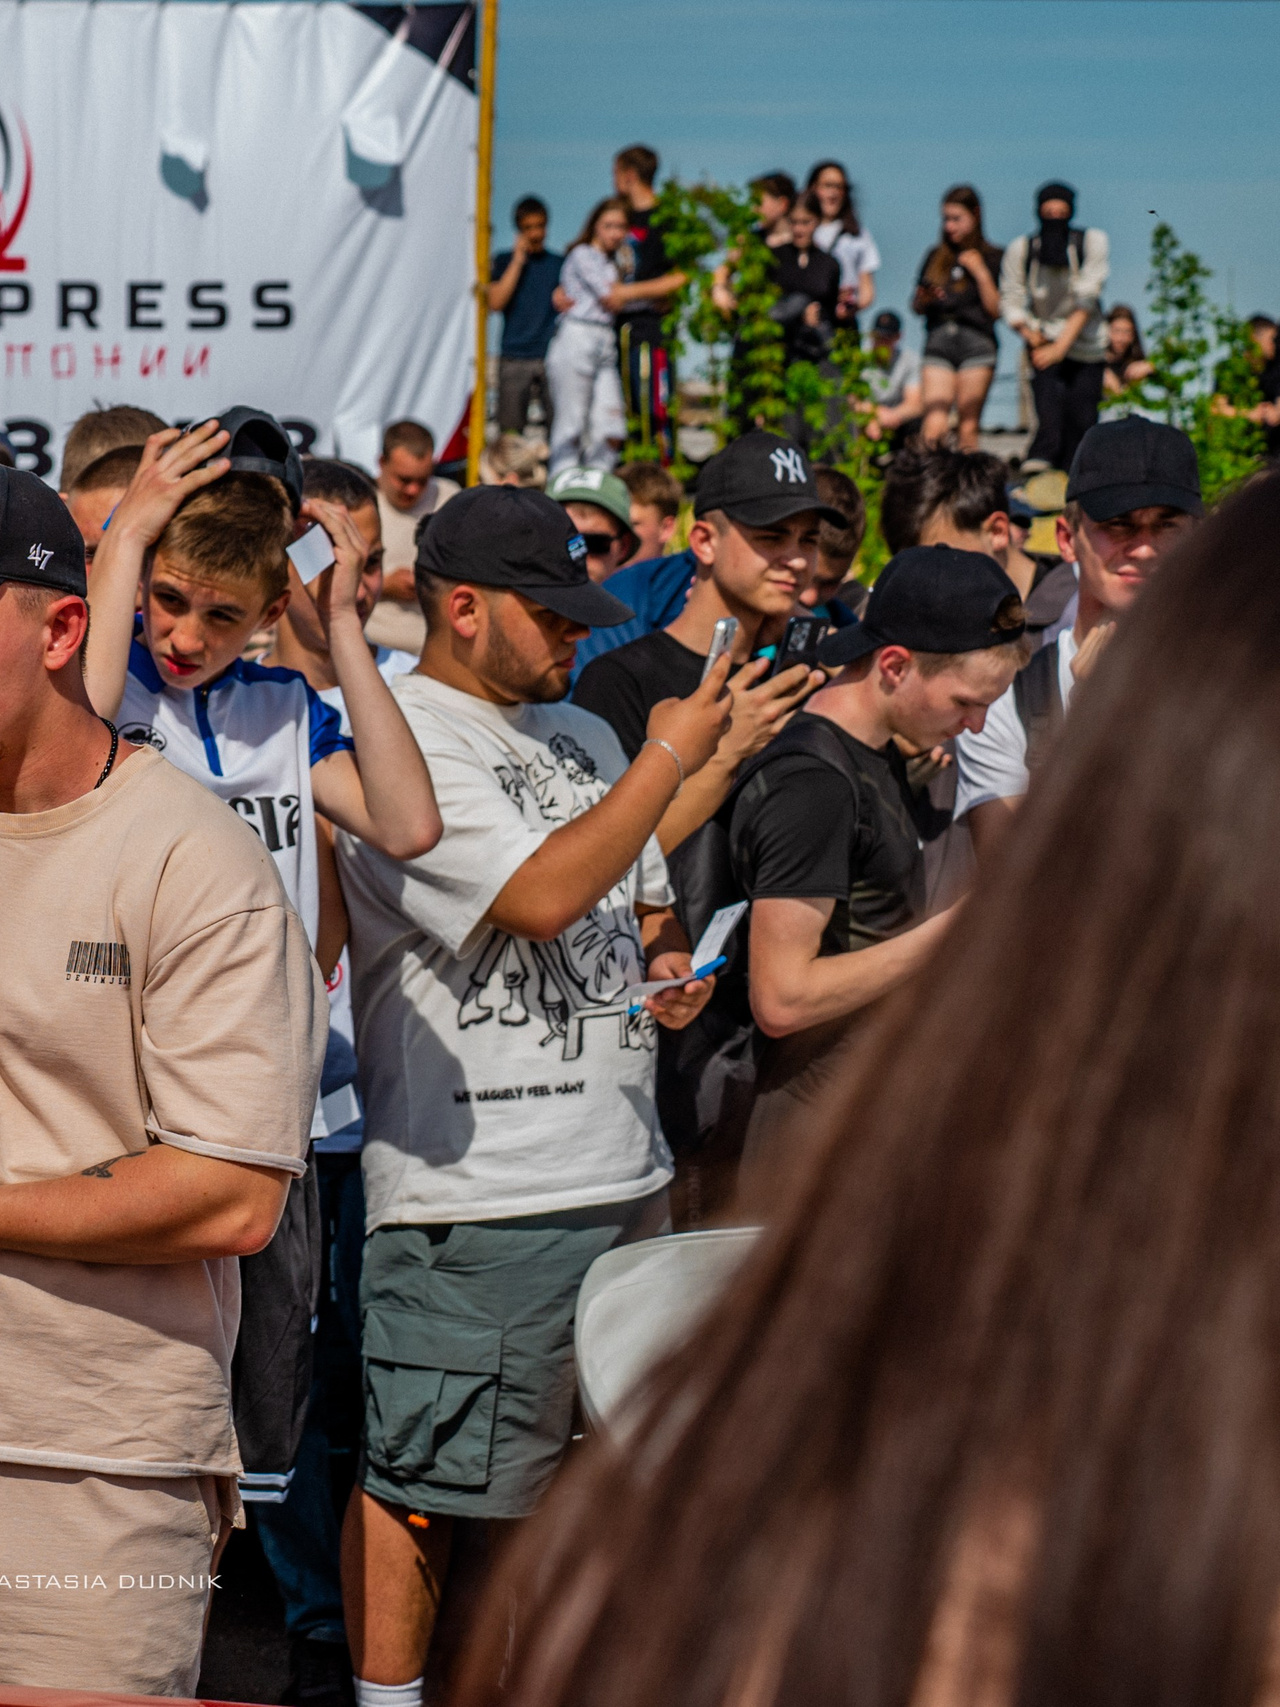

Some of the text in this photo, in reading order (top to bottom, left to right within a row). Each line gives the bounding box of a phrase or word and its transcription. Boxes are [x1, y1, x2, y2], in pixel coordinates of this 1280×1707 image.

[768, 447, 808, 484] NY
[475, 1086, 524, 1101] VAGUELY
[527, 1085, 551, 1097] FEEL
